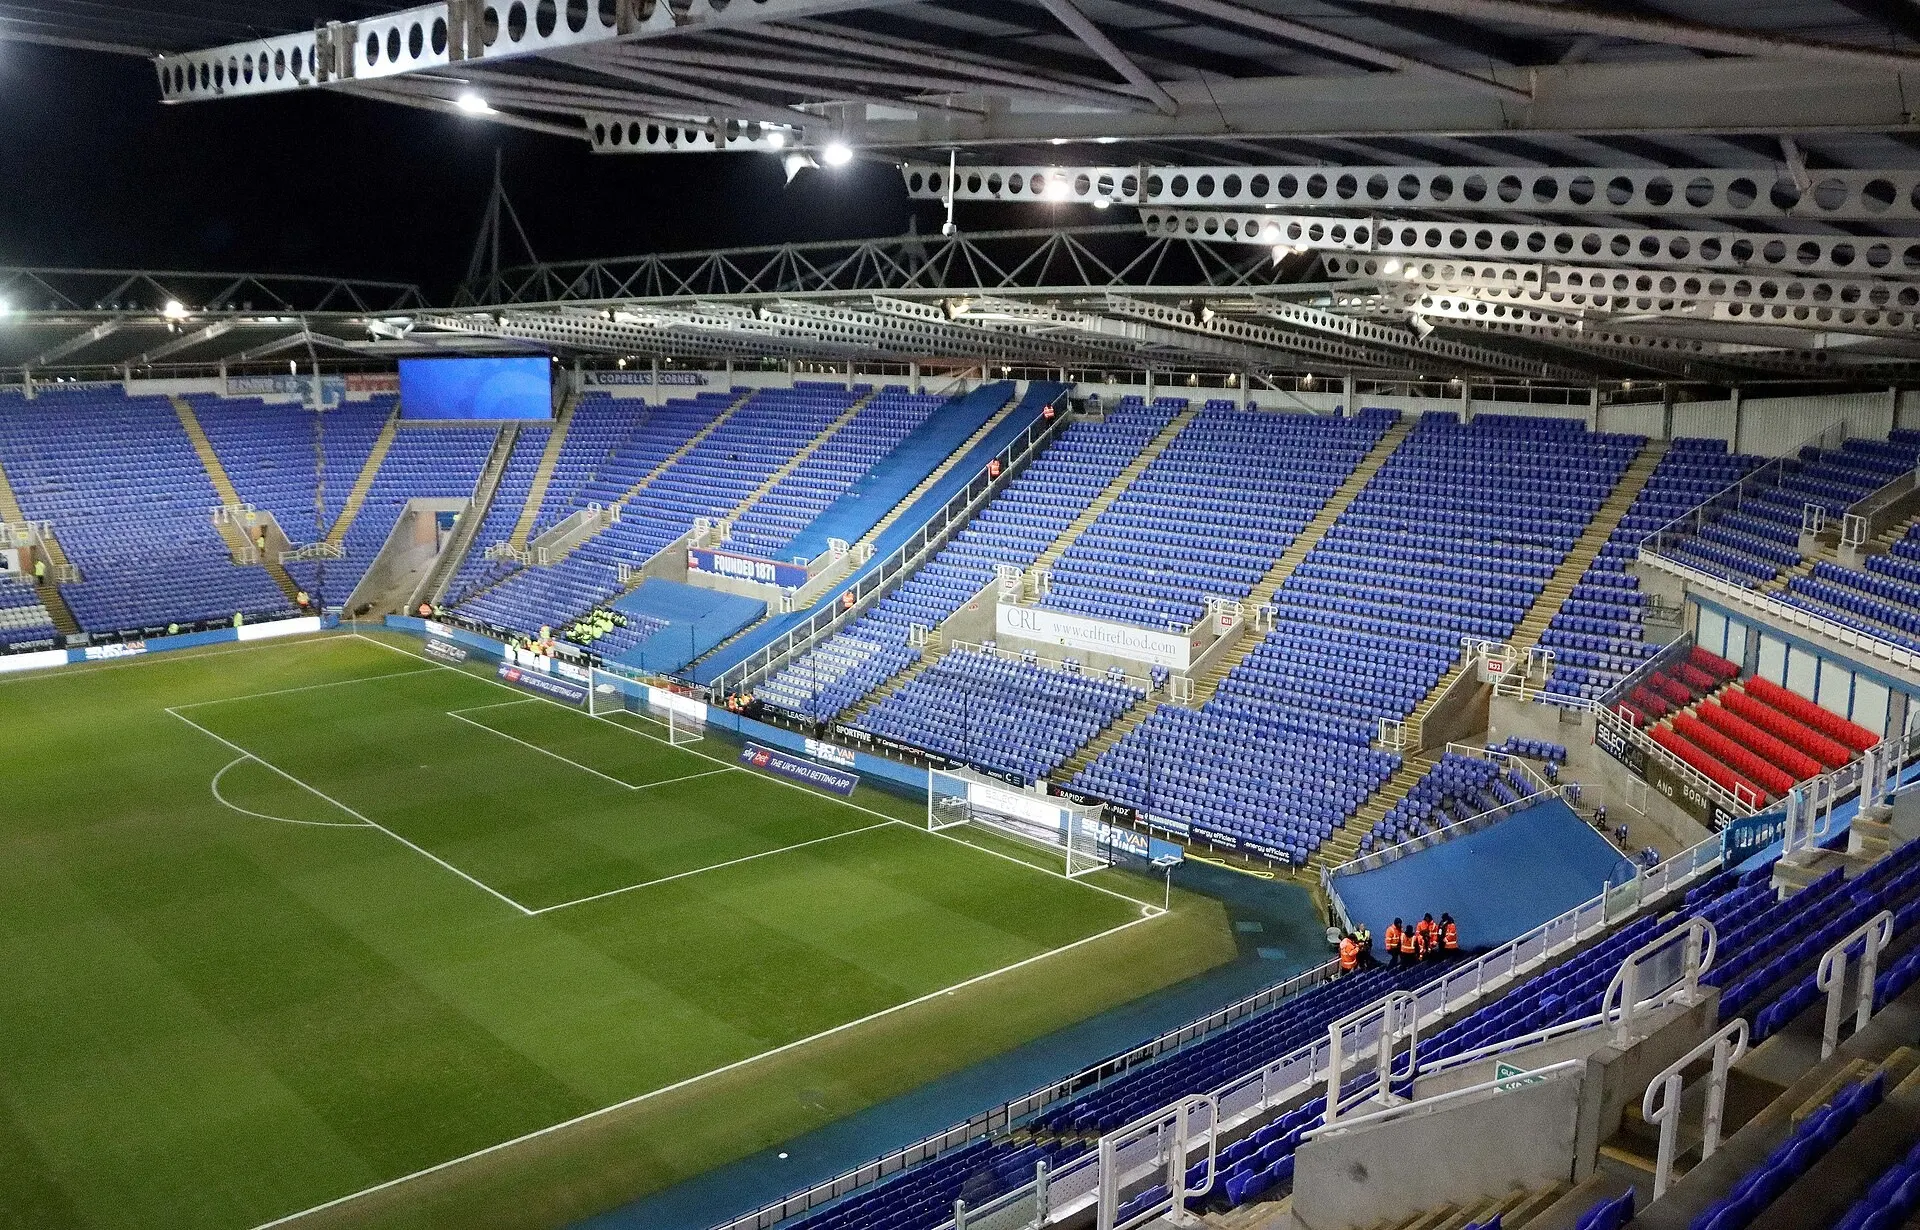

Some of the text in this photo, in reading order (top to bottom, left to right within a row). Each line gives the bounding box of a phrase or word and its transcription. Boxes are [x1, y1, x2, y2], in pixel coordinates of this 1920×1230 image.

[600, 374, 697, 385] COPPELL'S CORNER
[714, 554, 755, 577] FOUNDED
[755, 563, 776, 581] 1871
[1007, 608, 1176, 655] CRL www.crlfireflood.com
[9, 639, 54, 650] SPORTFIVE
[835, 724, 872, 742] SPORTFIVE
[1598, 724, 1626, 753] SELECT
[742, 748, 769, 763] sky bet
[836, 747, 855, 760] VAN
[770, 758, 850, 788] THE UK'S NO.1 BETTING APP
[1060, 790, 1084, 803] RAPIDZ
[1657, 779, 1707, 809] AND BORN
[1103, 803, 1130, 816] RPIDZ
[1081, 818, 1123, 840] SELECT
[1124, 831, 1148, 848] VAN
[1194, 827, 1213, 838] energy
[1213, 832, 1237, 844] efficient
[1246, 842, 1290, 858] energy efficient
